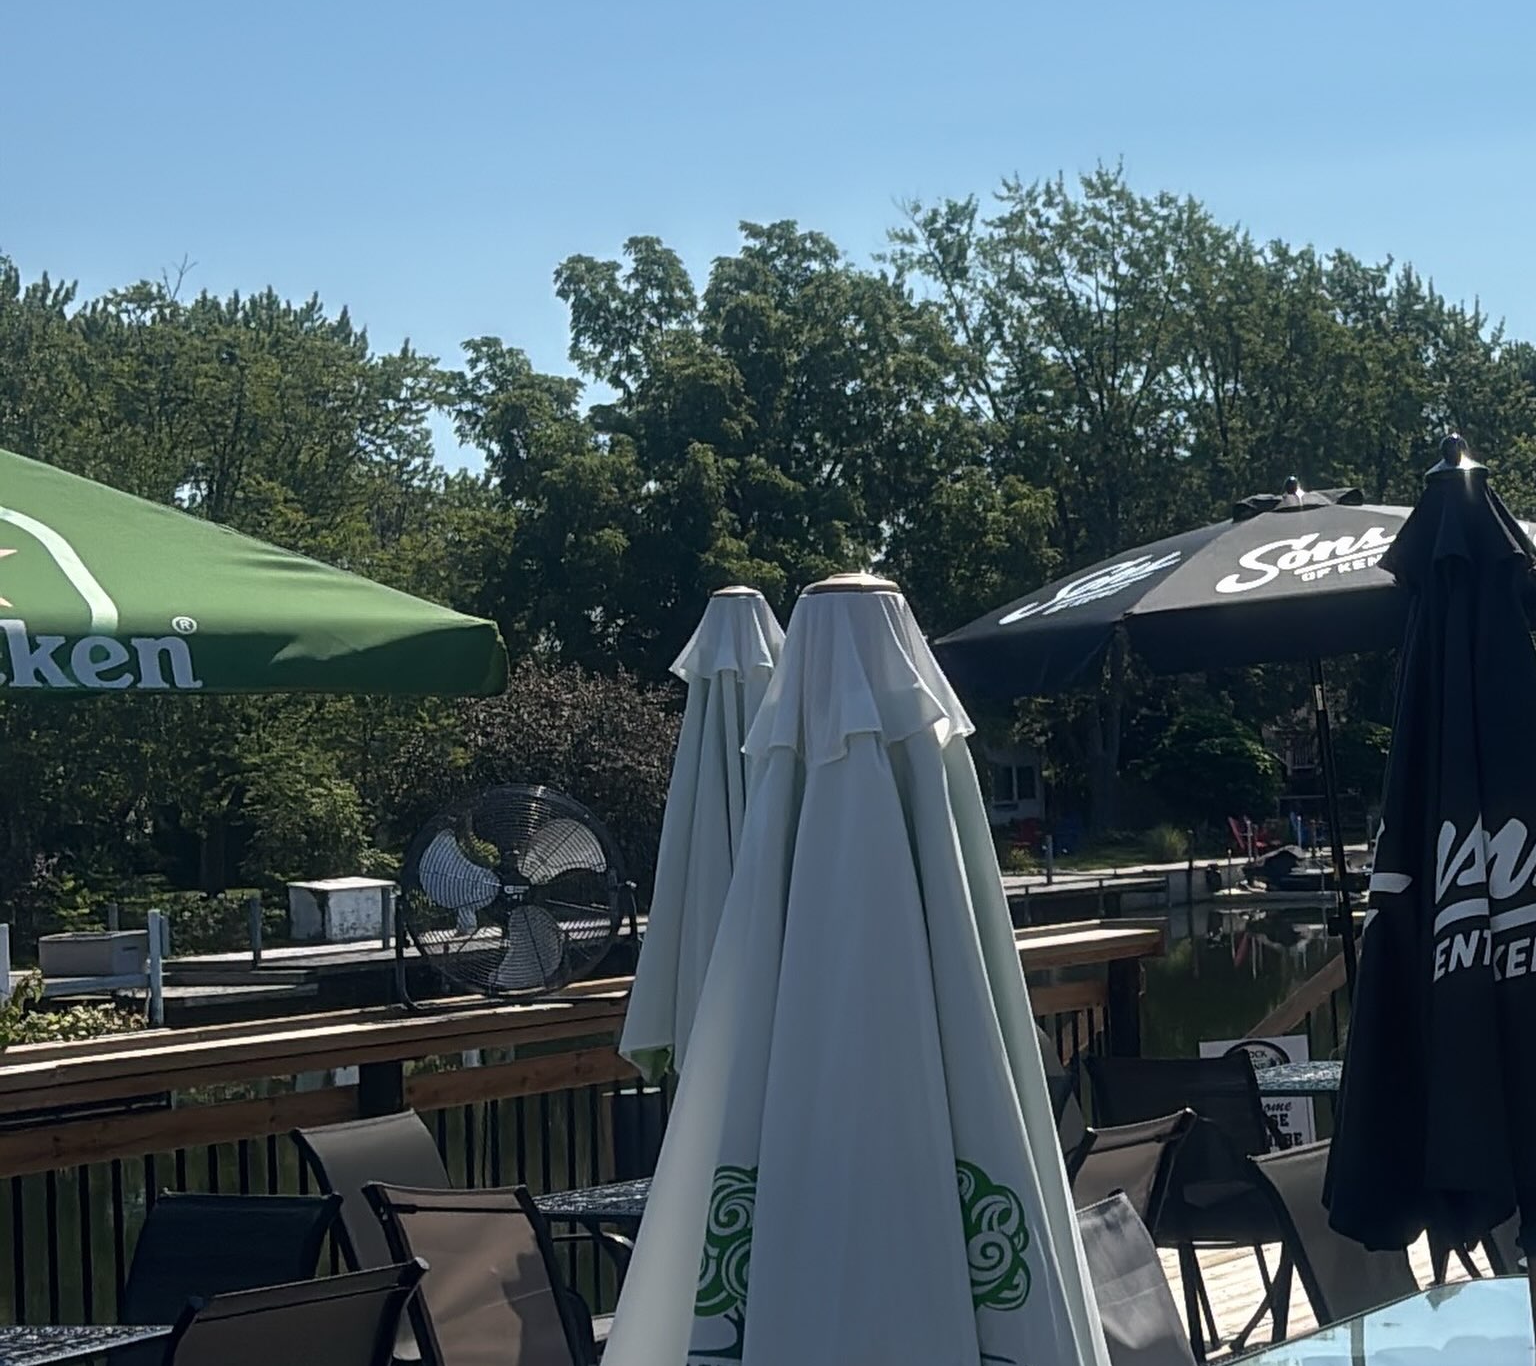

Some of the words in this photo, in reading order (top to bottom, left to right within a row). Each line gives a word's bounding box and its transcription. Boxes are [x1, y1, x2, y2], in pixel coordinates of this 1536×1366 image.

[1215, 527, 1398, 594] Sons
[1338, 554, 1384, 575] KEN
[0, 619, 204, 689] ken
